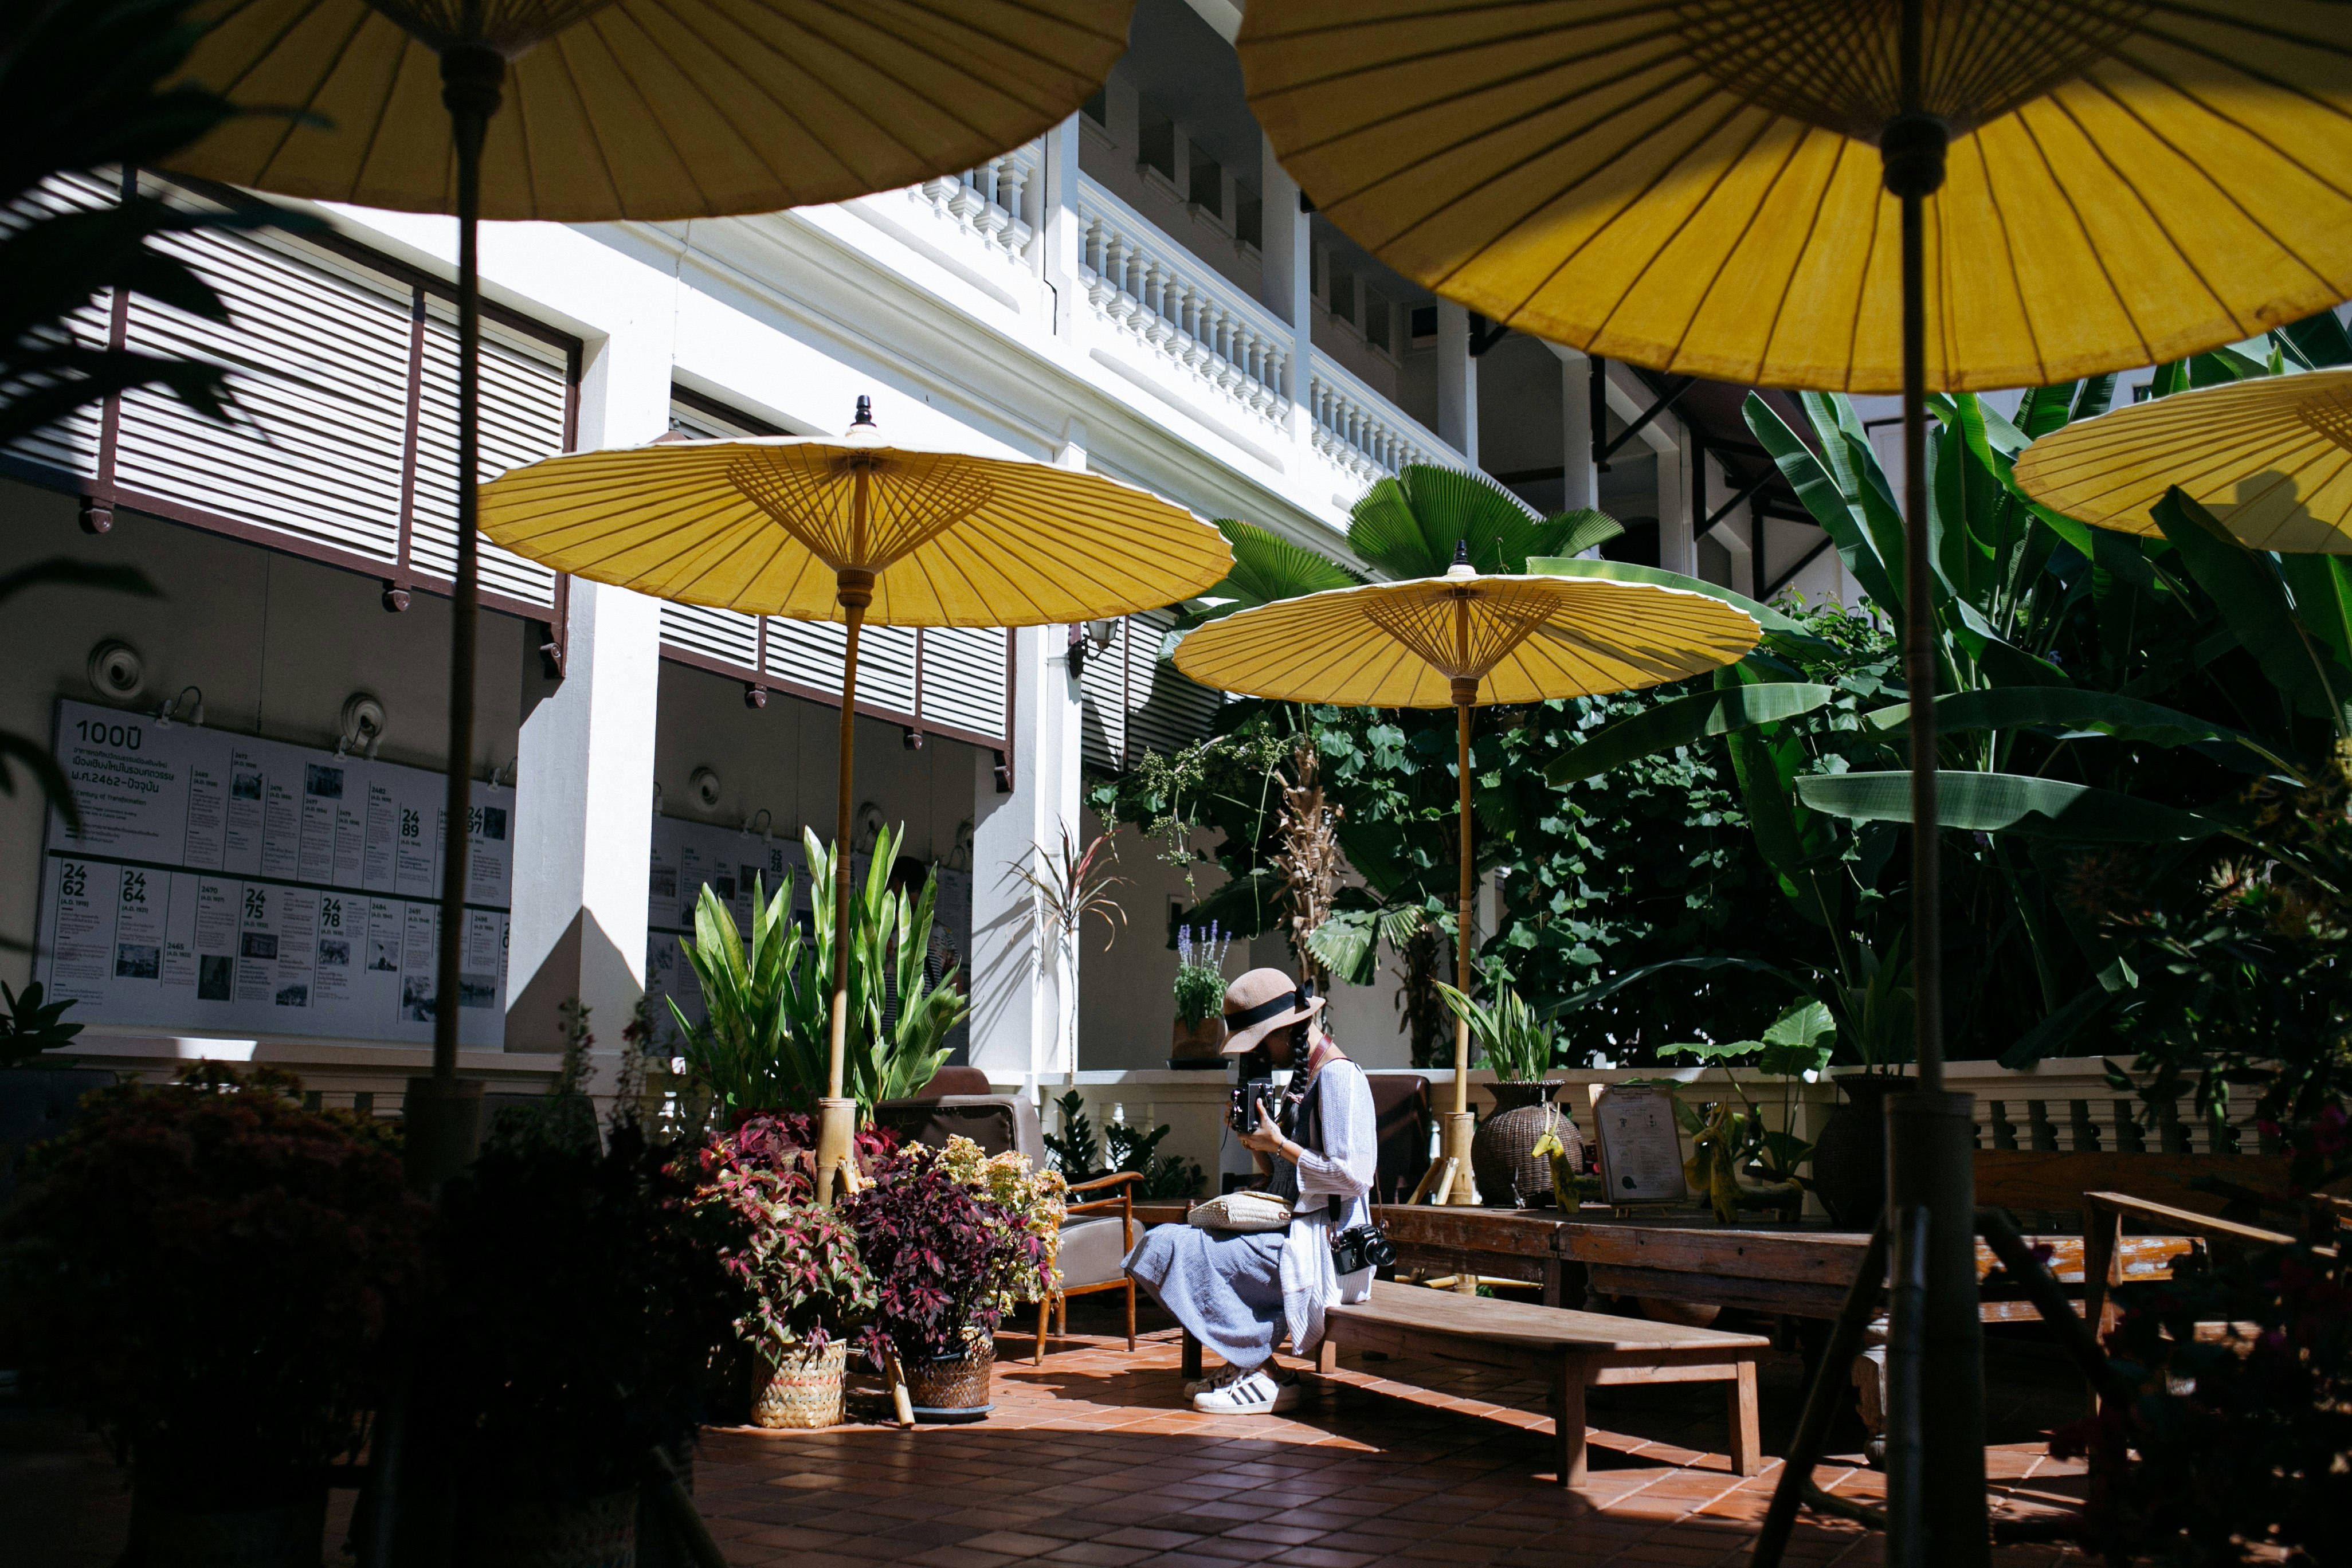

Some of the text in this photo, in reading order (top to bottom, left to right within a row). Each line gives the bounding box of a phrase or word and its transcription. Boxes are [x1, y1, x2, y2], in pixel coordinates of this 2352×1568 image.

[76, 720, 142, 750] 100ปี
[76, 790, 97, 799] Century
[108, 794, 147, 806] Transformation
[402, 809, 420, 824] 24
[402, 823, 420, 838] 89
[771, 849, 782, 861] 25
[64, 864, 87, 881] 24
[771, 860, 782, 872] 28
[124, 871, 146, 887] 24
[62, 880, 85, 897] 62
[123, 887, 146, 903] 64
[202, 886, 218, 894] 2470
[246, 888, 266, 904] 24
[245, 903, 264, 919] 75
[323, 897, 342, 912] 24
[323, 912, 340, 928] 78
